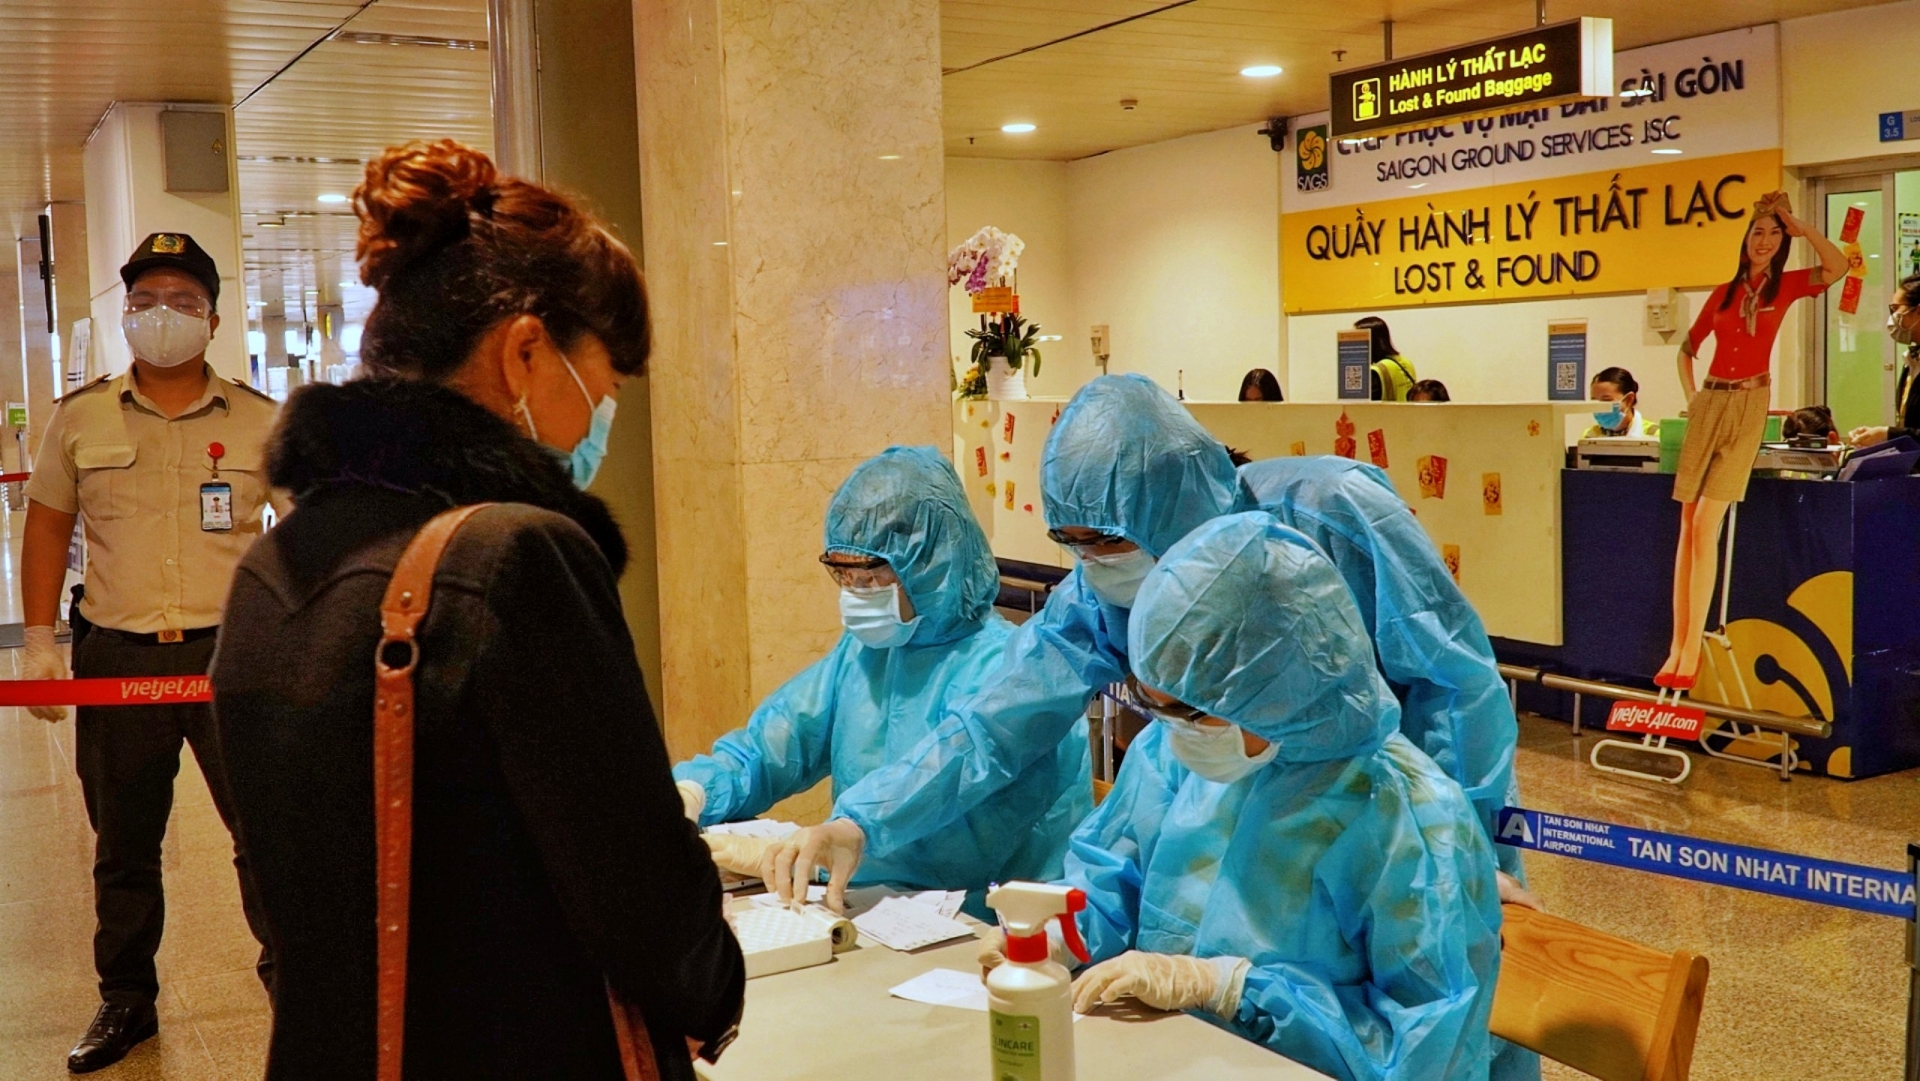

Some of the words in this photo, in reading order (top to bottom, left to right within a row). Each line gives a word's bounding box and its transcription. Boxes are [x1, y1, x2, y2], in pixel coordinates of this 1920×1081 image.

[1389, 67, 1433, 92] HÀNH
[1436, 58, 1457, 83] LÝ
[1460, 46, 1507, 77] THẤT
[1509, 43, 1547, 69] LẠC
[1674, 56, 1745, 99] GÒN
[1389, 95, 1420, 115] Lost
[1421, 92, 1434, 109] &
[1436, 80, 1481, 106] Found
[1484, 71, 1553, 98] Baggage
[1883, 127, 1900, 139] 3.5
[1886, 115, 1896, 126] G
[1376, 151, 1448, 182] SAIGON
[1450, 139, 1536, 172] GROUND
[1541, 123, 1634, 158] SERVICES
[1640, 115, 1681, 144] JSC
[1297, 172, 1329, 192] SAGS
[1305, 207, 1386, 261] QUẦY
[1399, 202, 1490, 253] HÀNH
[1505, 189, 1541, 242] LÝ
[1553, 172, 1649, 237] THẤT
[1664, 174, 1747, 228] LẠC
[1394, 261, 1456, 295] LOST
[1464, 258, 1487, 290] &
[1497, 250, 1600, 287] FOUND
[1542, 827, 1616, 849] INTERNATIONAL
[1543, 815, 1562, 827] TAN
[1563, 818, 1584, 830] SON
[1584, 821, 1611, 835] NHAT
[1542, 840, 1584, 855] AIRPORT
[1628, 836, 1672, 864] TAN
[1678, 846, 1729, 874] SON
[1735, 857, 1801, 886] NHAT
[1807, 868, 1916, 906] INTERNA
